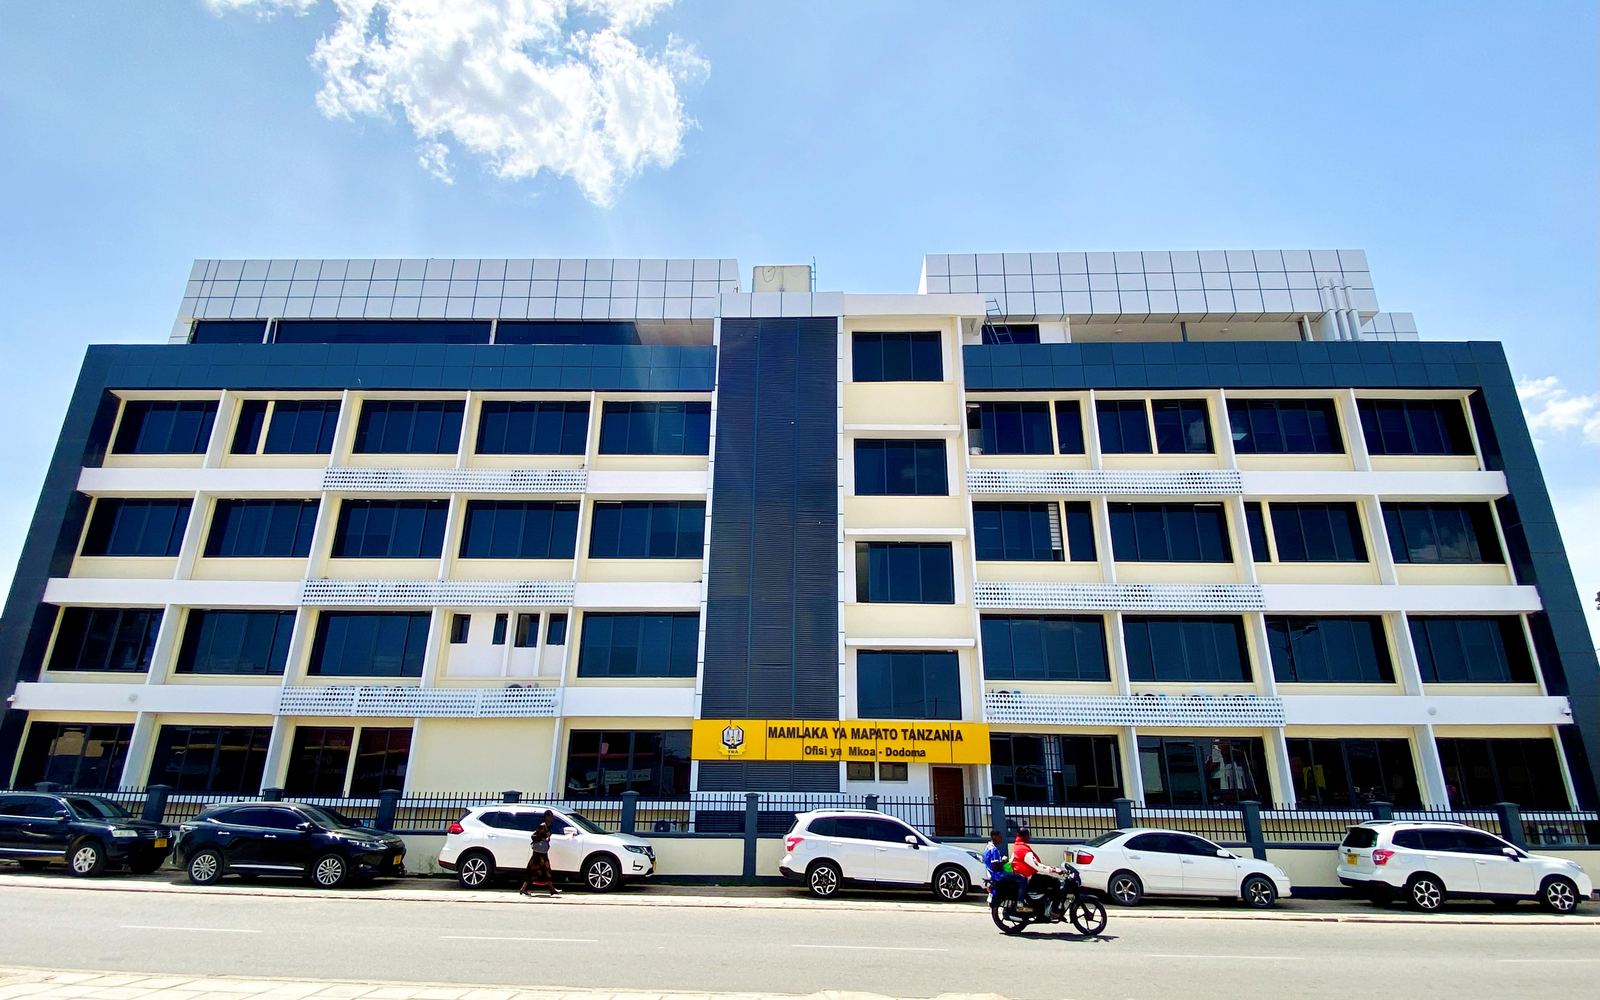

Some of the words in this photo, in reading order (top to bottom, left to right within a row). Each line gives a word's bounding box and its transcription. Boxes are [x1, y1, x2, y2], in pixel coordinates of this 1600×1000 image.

[768, 726, 828, 739] MAMLAKA
[832, 727, 847, 739] YA
[851, 728, 898, 740] MAPATO
[901, 729, 963, 741] TANZANIA
[805, 746, 827, 756] Ofisi
[830, 748, 842, 758] ya
[849, 746, 876, 756] Mkoa
[885, 747, 926, 757] Dodoma
